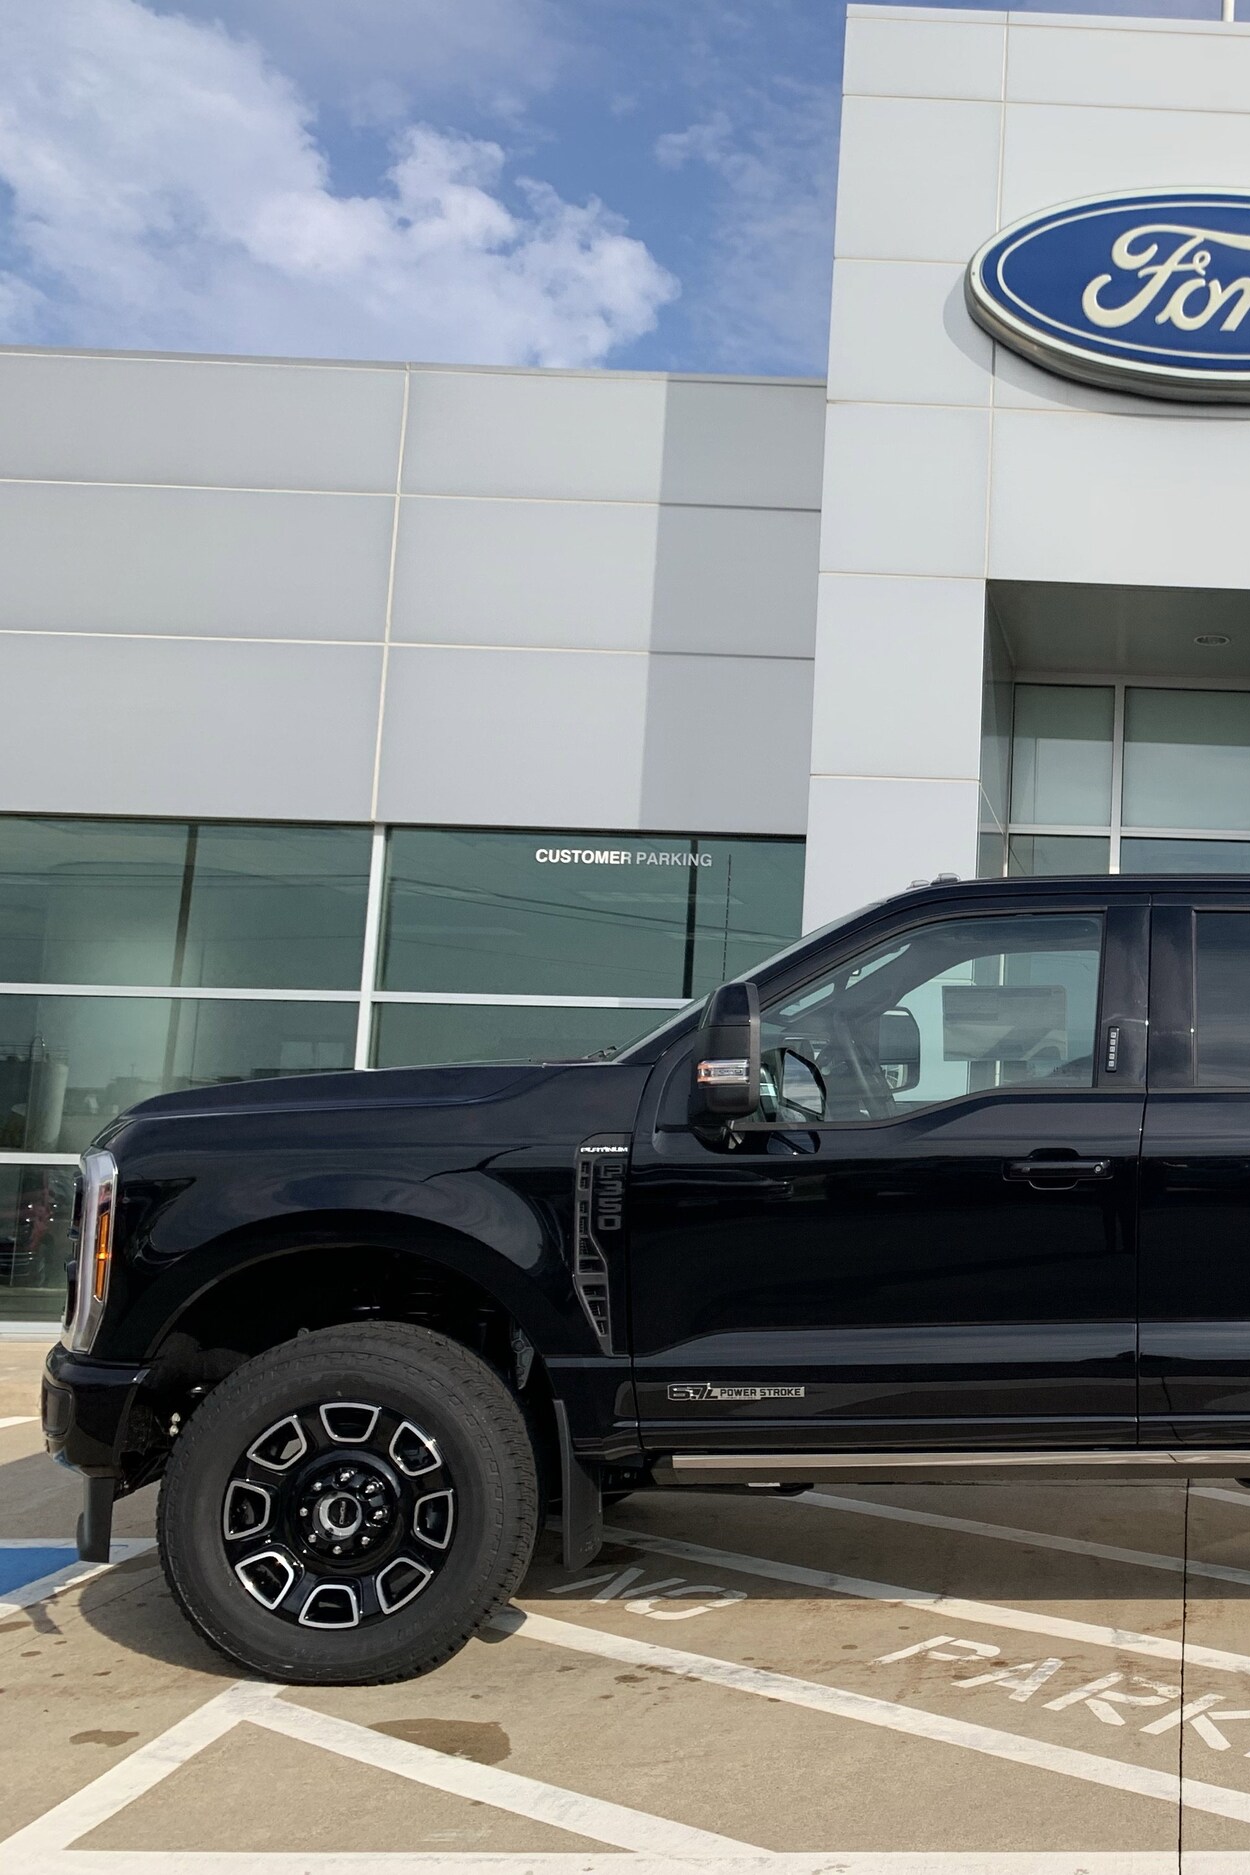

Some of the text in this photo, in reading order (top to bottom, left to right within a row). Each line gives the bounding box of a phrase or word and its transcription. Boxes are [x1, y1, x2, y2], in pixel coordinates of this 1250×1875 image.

[535, 848, 713, 867] CUSTOMER PARKING
[719, 1388, 757, 1397] POWER
[759, 1388, 801, 1397] STROKE
[547, 1567, 748, 1621] NO
